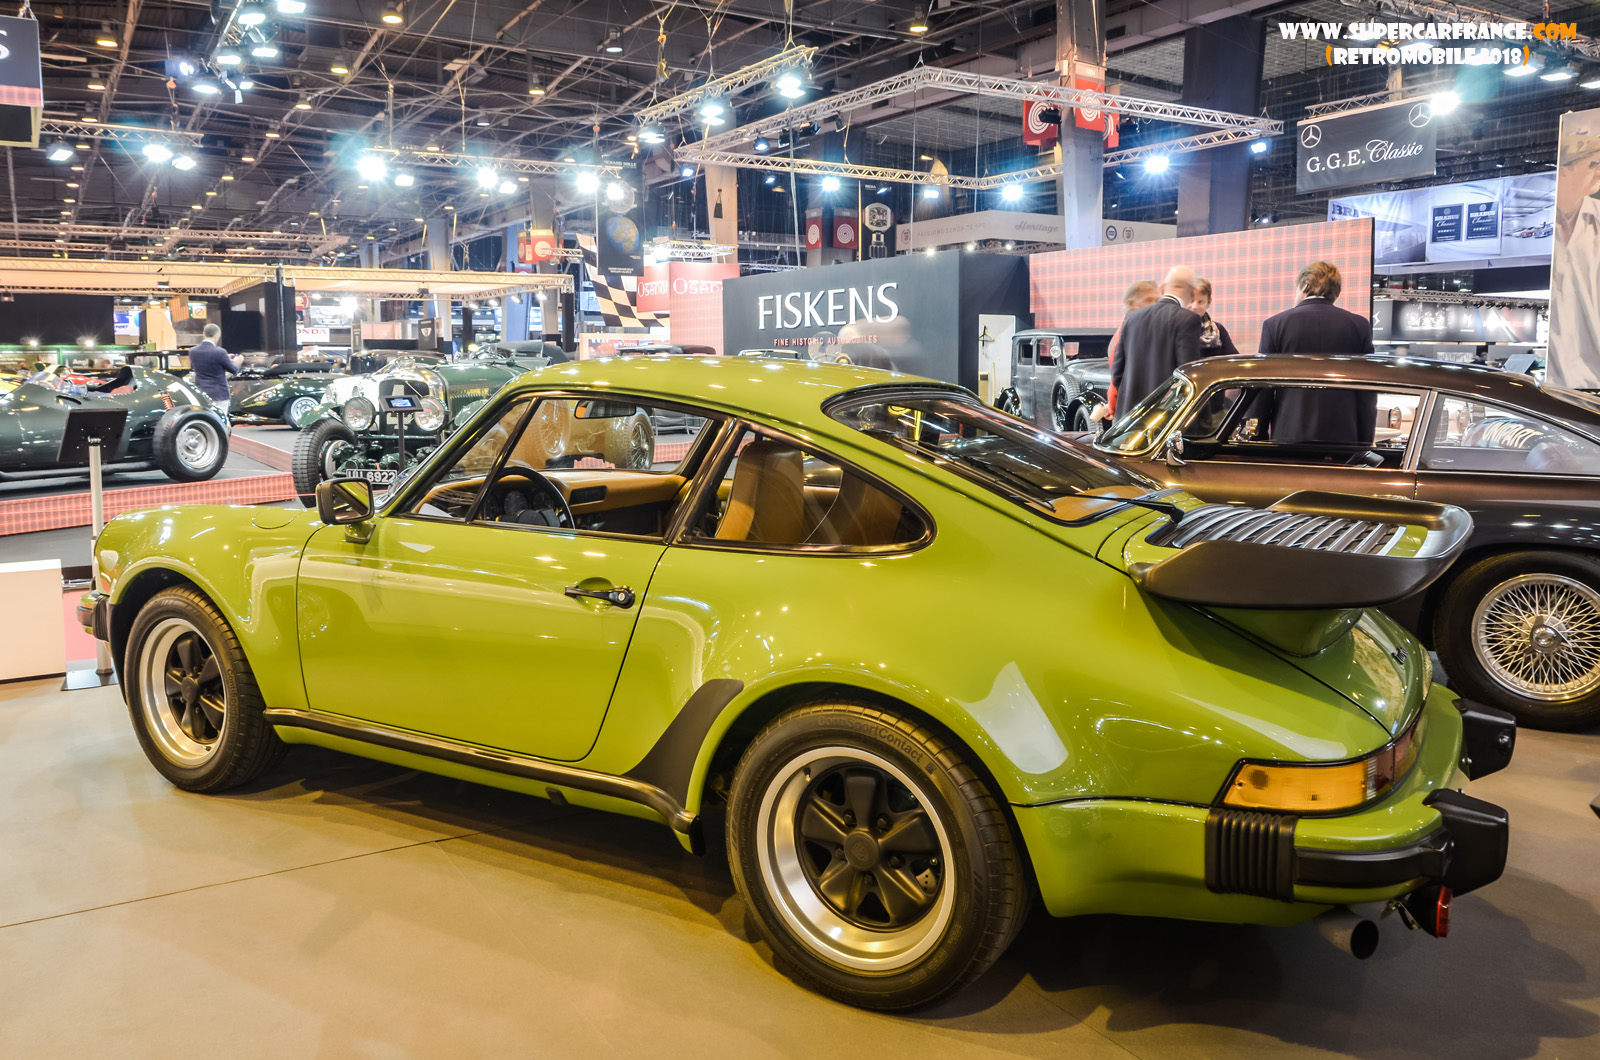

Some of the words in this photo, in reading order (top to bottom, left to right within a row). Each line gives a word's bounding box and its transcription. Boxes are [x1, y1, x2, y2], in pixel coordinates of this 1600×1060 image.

[1306, 149, 1366, 173] G.G.E.
[1365, 139, 1424, 163] Classic
[758, 282, 899, 330] FISKENS
[773, 338, 789, 347] FINE
[792, 337, 824, 347] HISTORIC
[366, 471, 396, 484] 6922
